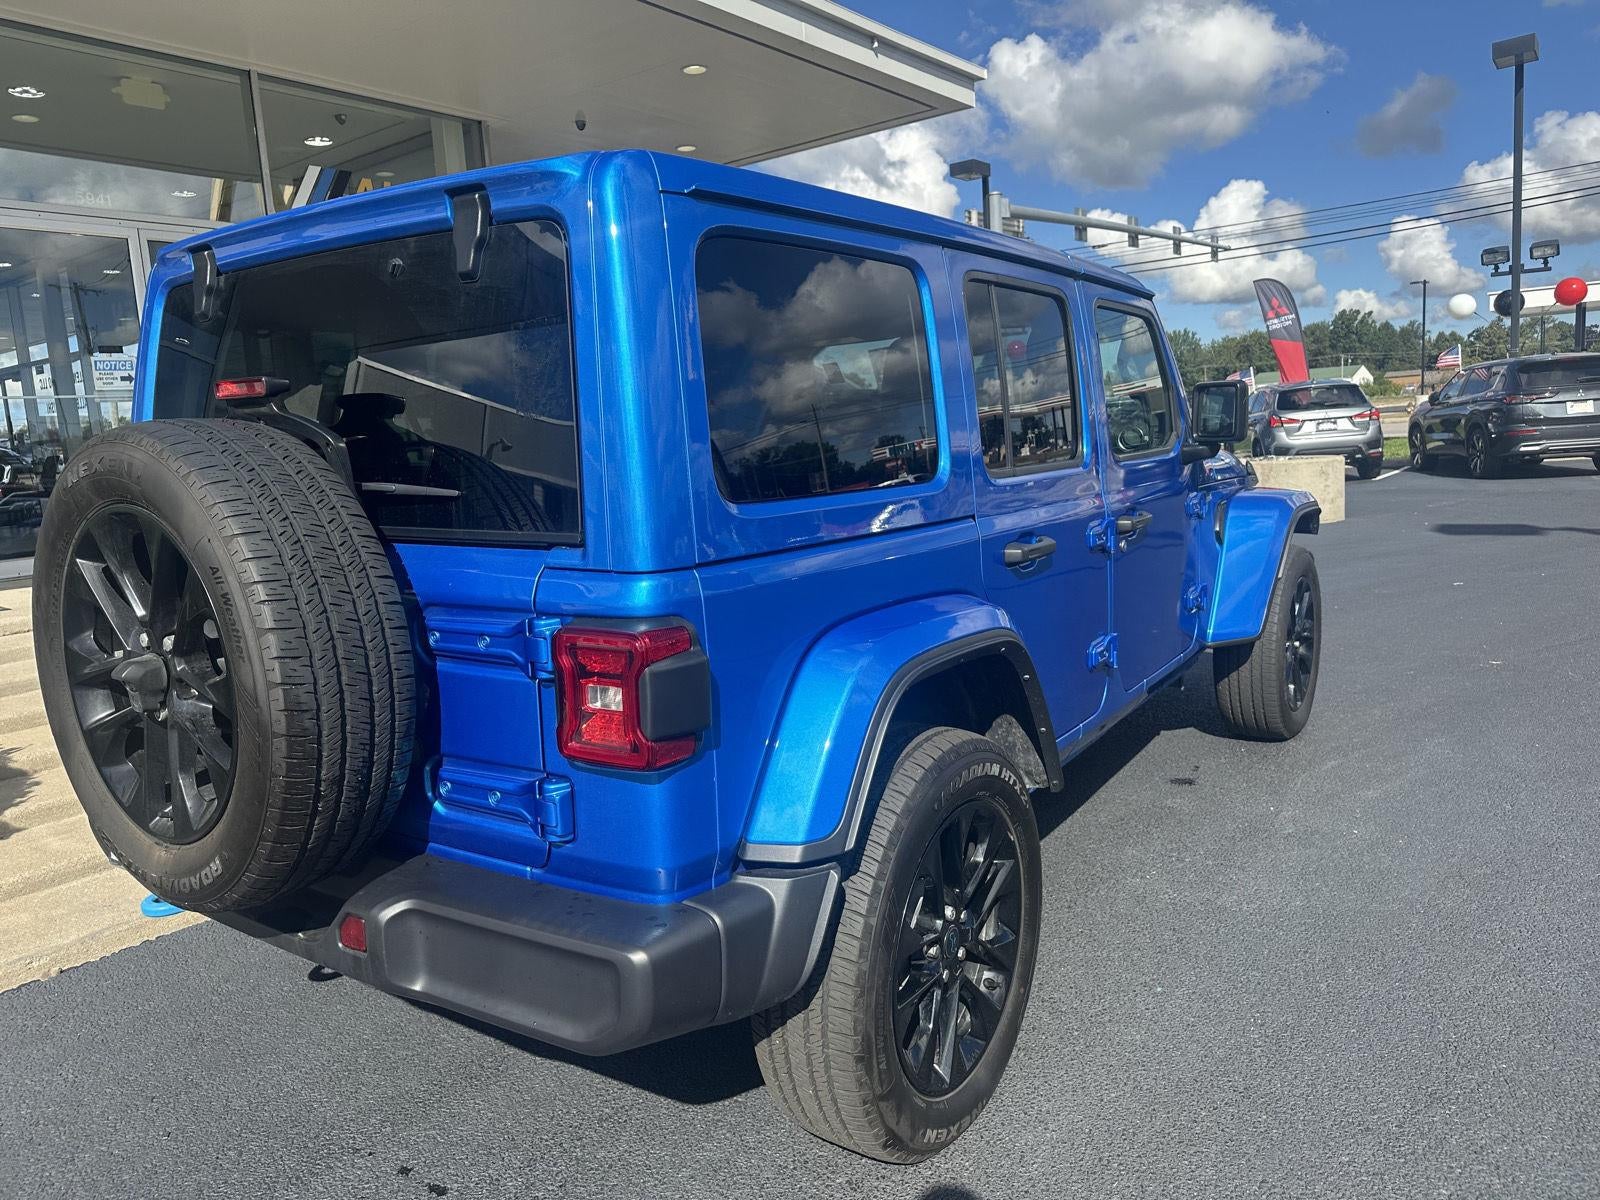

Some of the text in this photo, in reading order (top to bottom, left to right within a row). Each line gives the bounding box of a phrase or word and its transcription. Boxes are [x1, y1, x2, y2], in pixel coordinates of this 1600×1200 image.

[96, 361, 132, 370] NOTICE
[65, 456, 134, 488] NEXEN
[209, 566, 246, 663] All-Weather
[950, 763, 1000, 793] ROADIAN
[1001, 768, 1022, 796] HTX
